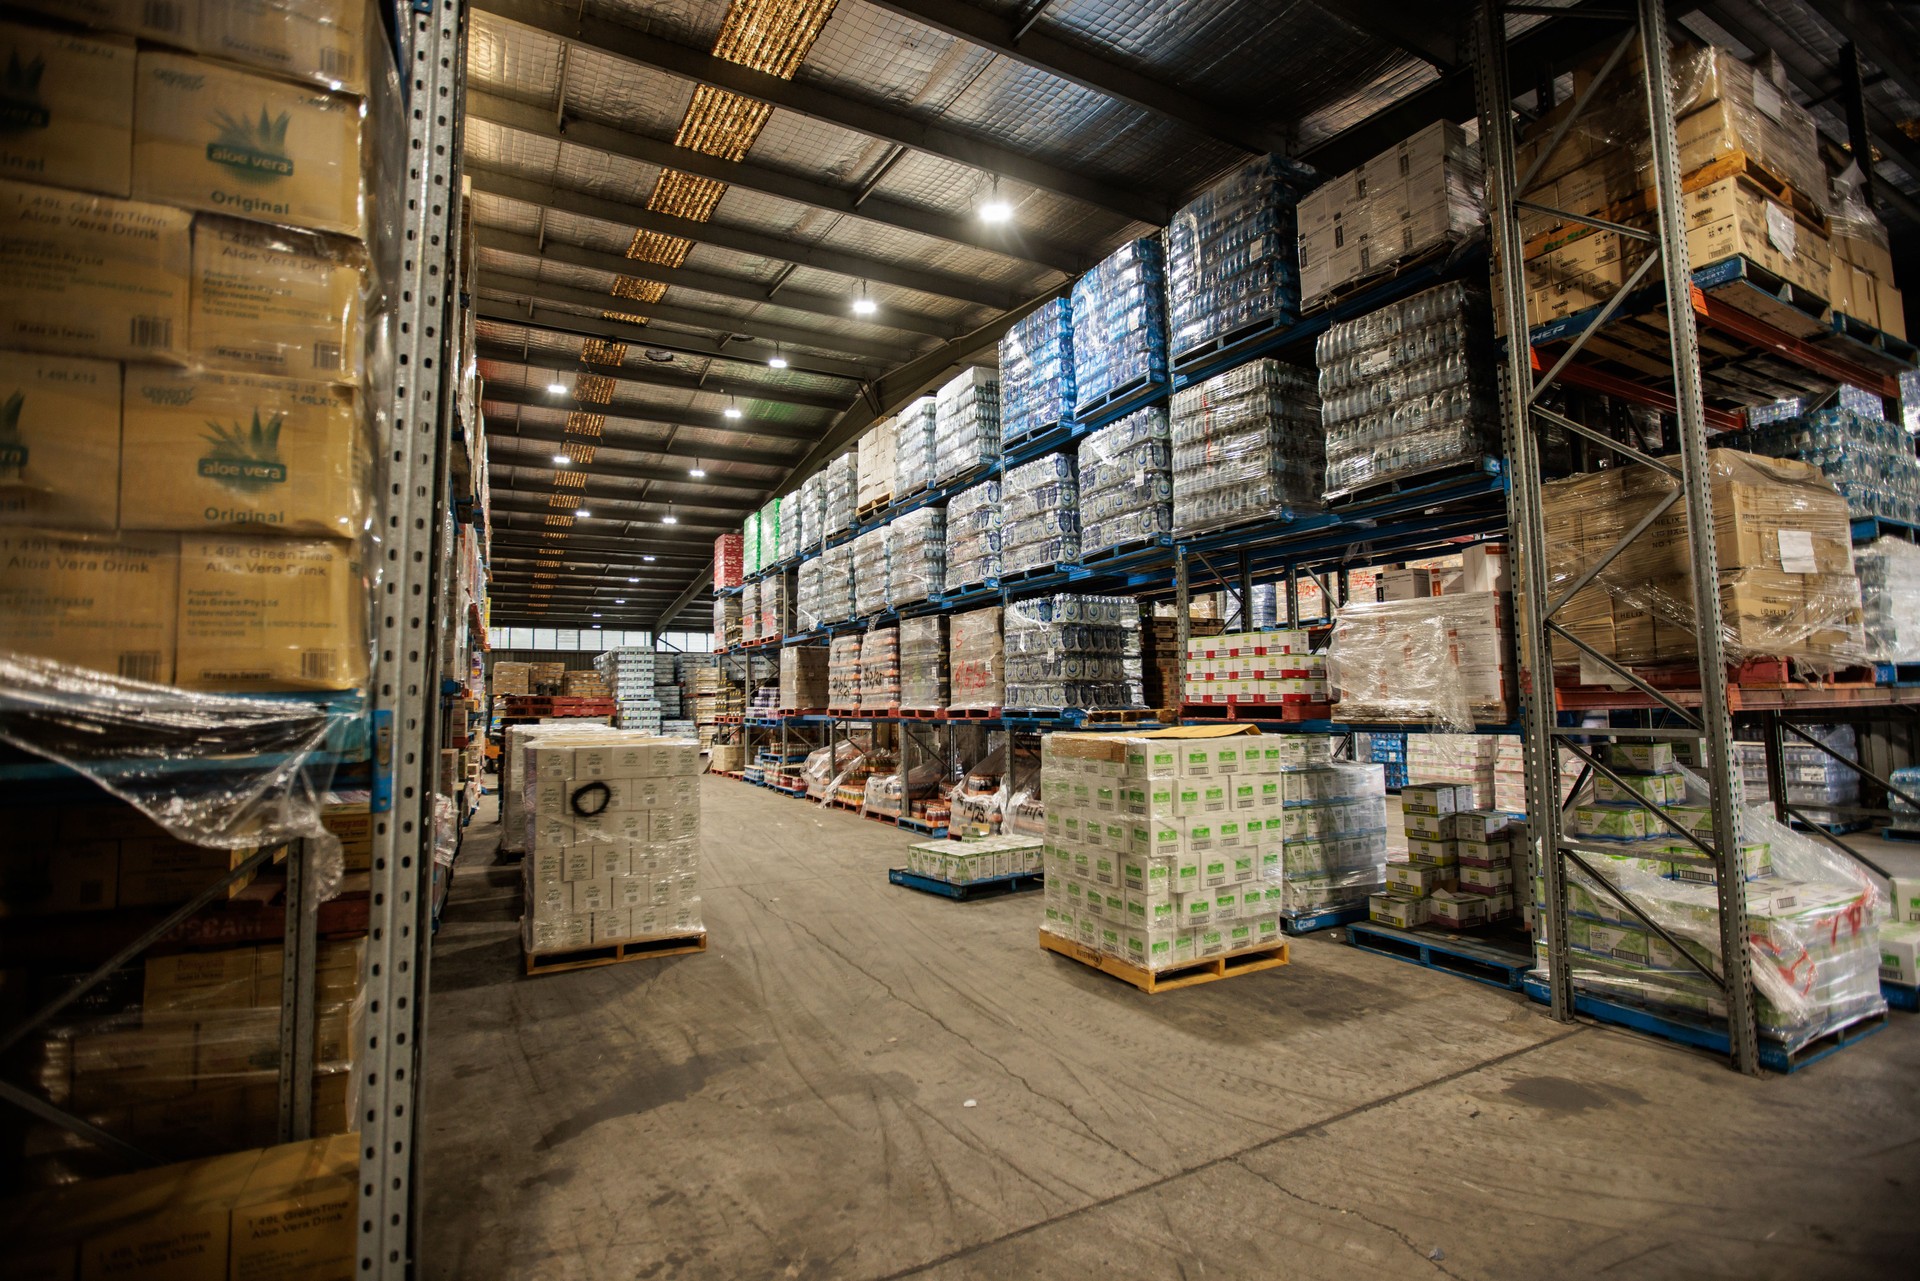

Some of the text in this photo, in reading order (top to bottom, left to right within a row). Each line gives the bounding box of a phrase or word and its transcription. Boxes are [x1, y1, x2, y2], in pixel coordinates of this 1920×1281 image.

[211, 147, 289, 173] aloe vera
[211, 191, 289, 215] Original
[20, 208, 159, 241] Aloe Vera Drink
[221, 245, 257, 261] Aloe
[261, 253, 298, 270] Vera
[203, 462, 282, 480] aloe vera
[204, 506, 284, 524] Original
[1651, 517, 1681, 526] HELIX
[7, 556, 150, 573] Aloe Vera Drink
[246, 562, 282, 575] Vera
[1620, 610, 1644, 619] HELIX
[248, 1214, 281, 1228] 1.49L
[251, 1212, 343, 1241] Aloe Vera Drink
[170, 1244, 206, 1261] Drink
